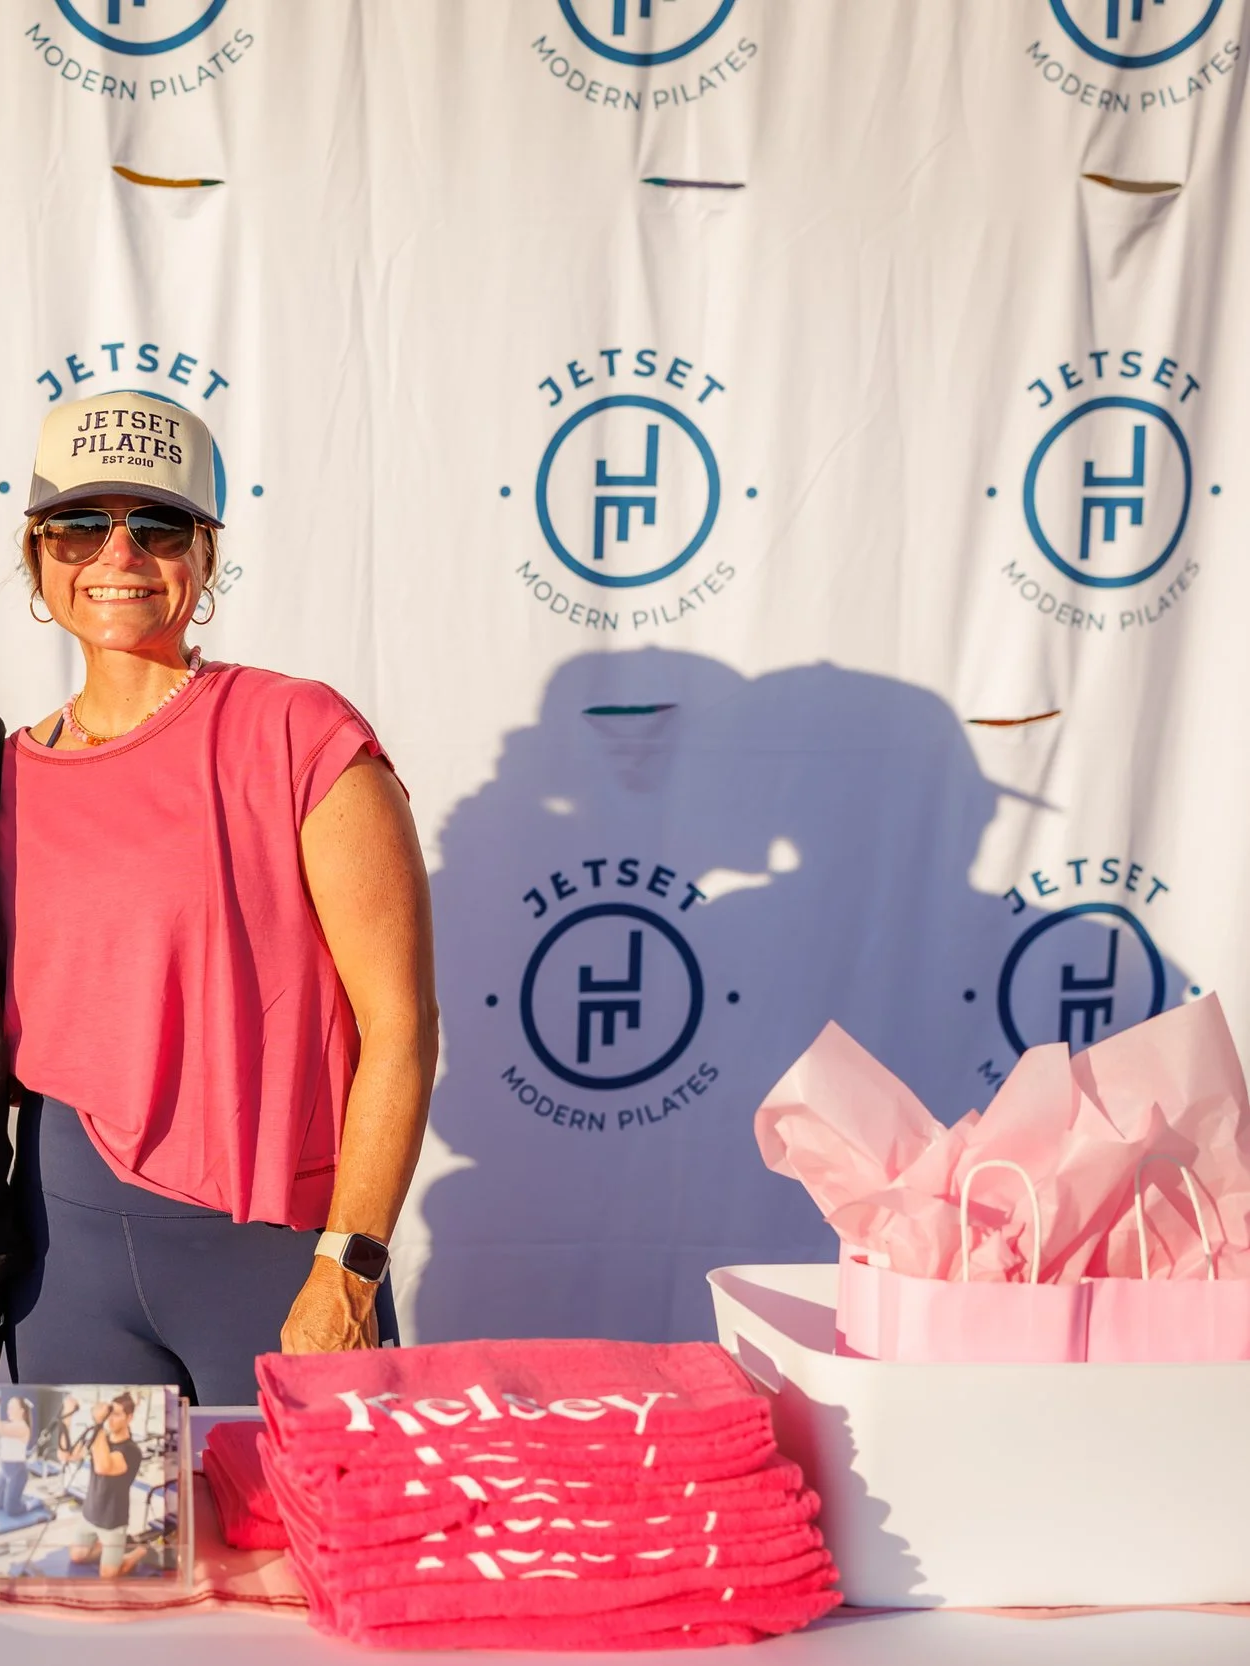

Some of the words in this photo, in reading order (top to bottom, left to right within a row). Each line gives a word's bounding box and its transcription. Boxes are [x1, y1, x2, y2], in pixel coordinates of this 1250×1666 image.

[24, 22, 138, 101] MODERN
[150, 28, 255, 100] PILATES
[531, 34, 643, 112] MODERN
[653, 36, 758, 110] PILATES
[1025, 40, 1131, 113] MODERN
[1140, 39, 1241, 113] PILATES
[36, 342, 230, 403] JETSET
[537, 348, 726, 407] JETSET
[1027, 350, 1201, 408] JETSET
[71, 433, 183, 465] PILATES
[77, 409, 180, 439] JETSET
[101, 455, 125, 464] EST
[127, 456, 154, 468] 2010
[516, 560, 619, 631] MODERN
[632, 560, 736, 630] PILATES
[1001, 560, 1106, 631] MODERN
[1120, 558, 1200, 631] PILATES
[522, 858, 707, 919] JETSET
[1003, 858, 1170, 916] JETSET
[501, 1065, 606, 1132] MODERN
[617, 1061, 720, 1131] PILATES
